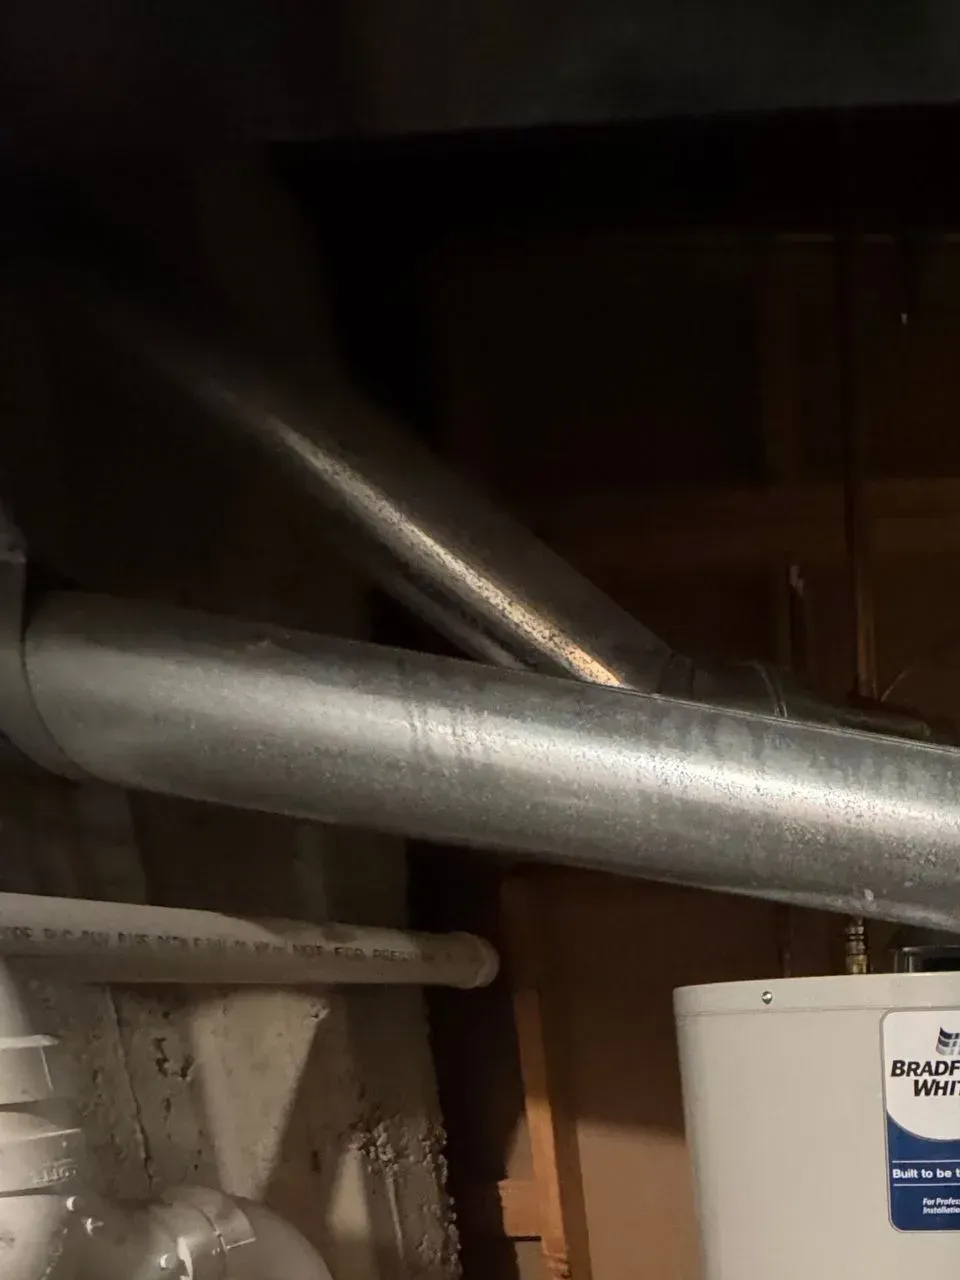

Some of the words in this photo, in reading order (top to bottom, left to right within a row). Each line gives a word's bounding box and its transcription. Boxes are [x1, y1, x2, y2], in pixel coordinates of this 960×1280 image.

[892, 1168, 918, 1179] Built
[921, 1169, 933, 1179] to
[936, 1168, 952, 1178] be
[922, 1197, 935, 1206] For
